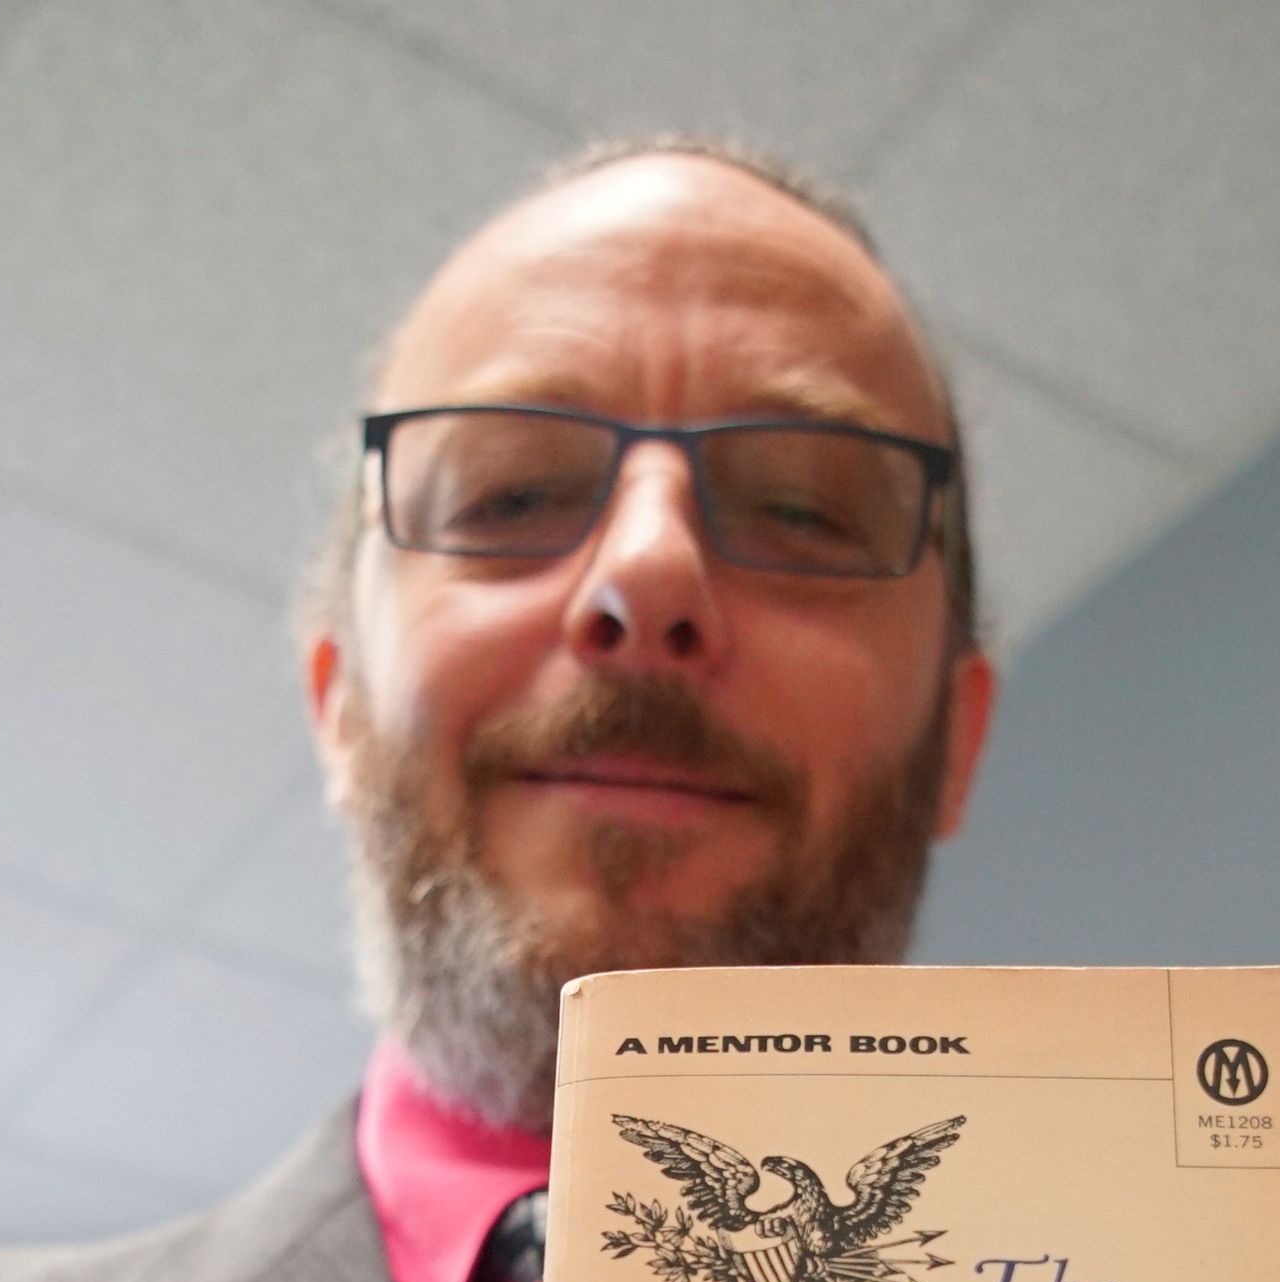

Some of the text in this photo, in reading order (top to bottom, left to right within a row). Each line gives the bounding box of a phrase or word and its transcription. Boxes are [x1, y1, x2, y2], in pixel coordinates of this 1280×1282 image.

[615, 1033, 971, 1056] A MENTOR BOOK
[1198, 1114, 1273, 1130] ME1208
[1210, 1133, 1264, 1150] $1.75
